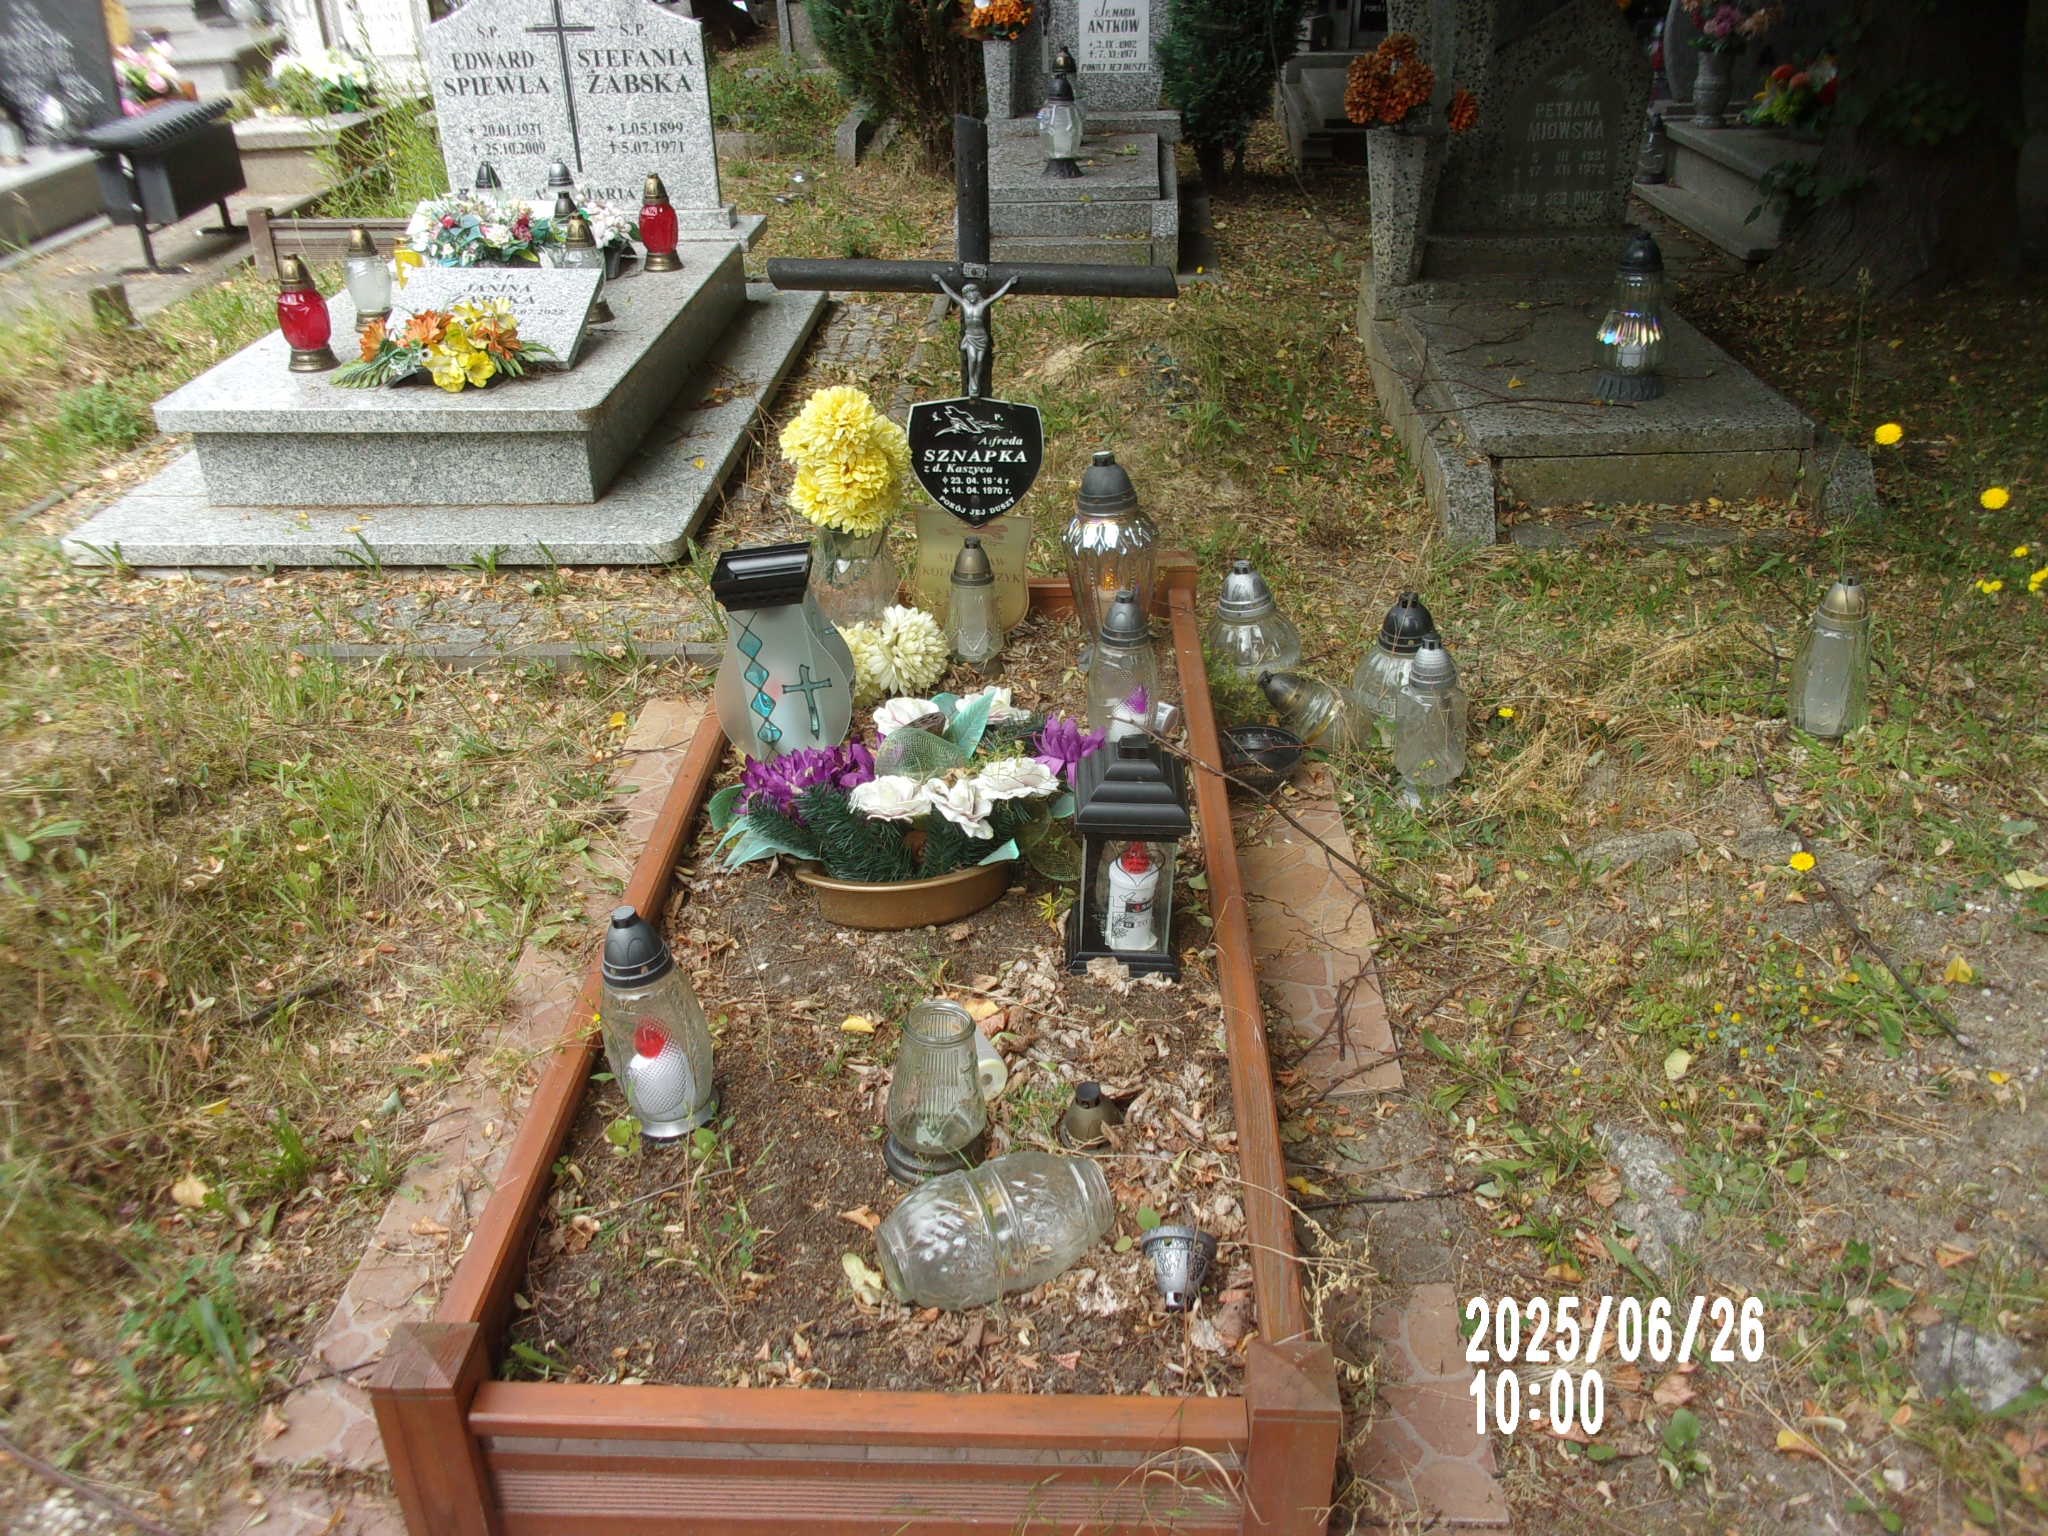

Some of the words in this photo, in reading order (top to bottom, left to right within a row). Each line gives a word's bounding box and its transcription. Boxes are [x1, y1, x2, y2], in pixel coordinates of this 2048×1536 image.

[451, 49, 535, 71] EDWARD
[577, 48, 694, 68] STEFANIA
[586, 68, 693, 94] ŻABSKA
[923, 449, 1028, 463] SZNAPKA
[932, 464, 942, 473] d.
[946, 463, 993, 475] Kaszyca
[950, 477, 963, 485] 23.
[966, 477, 979, 485] 04.
[982, 477, 1003, 485] 194
[951, 487, 964, 495] 14.
[966, 487, 980, 495] 04.
[982, 487, 1003, 495] 1970
[939, 495, 966, 514] POKÓJ
[969, 508, 986, 516] JEJ
[989, 496, 1015, 514] DUSZY
